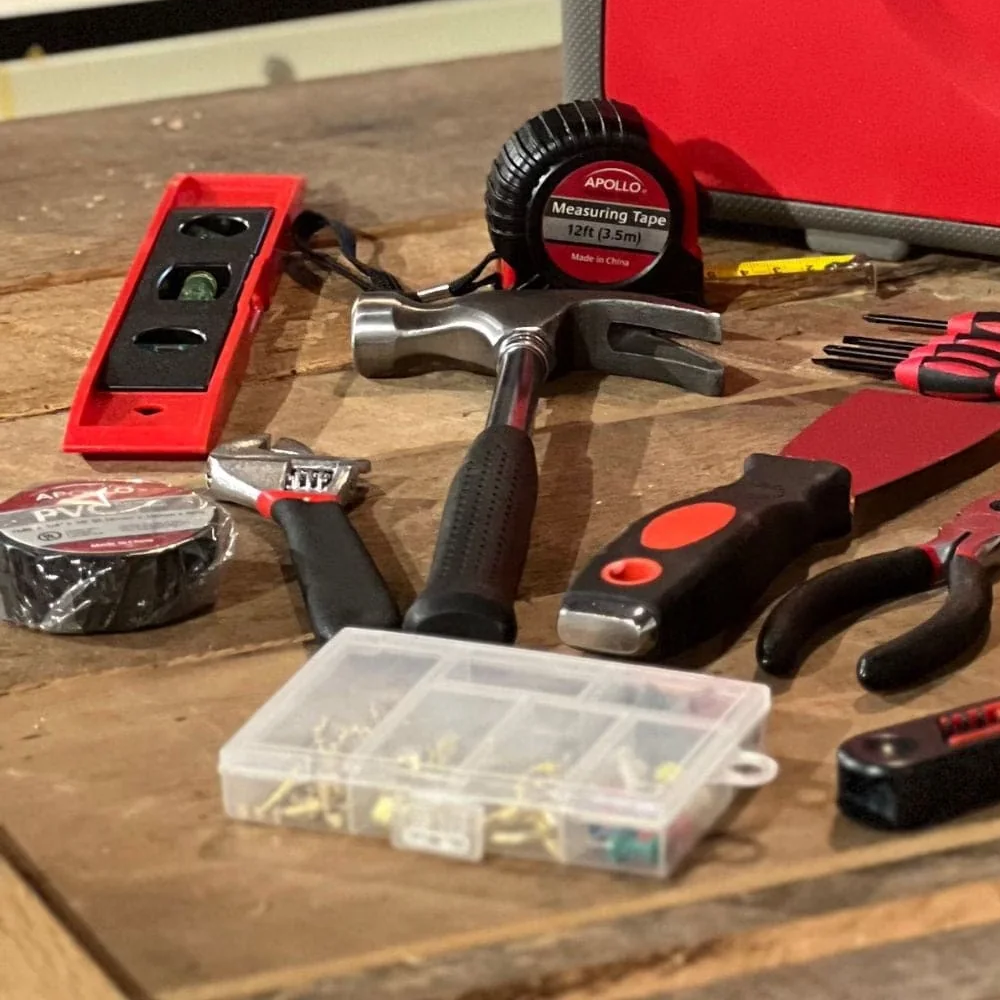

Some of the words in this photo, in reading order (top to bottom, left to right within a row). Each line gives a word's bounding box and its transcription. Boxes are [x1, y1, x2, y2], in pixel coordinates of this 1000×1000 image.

[552, 201, 628, 224] Measuring
[632, 210, 667, 226] Tape
[567, 224, 595, 238] 12ft
[597, 227, 642, 246] (3.5m)
[571, 253, 595, 263] Made
[595, 254, 604, 263] in
[606, 256, 630, 267] China
